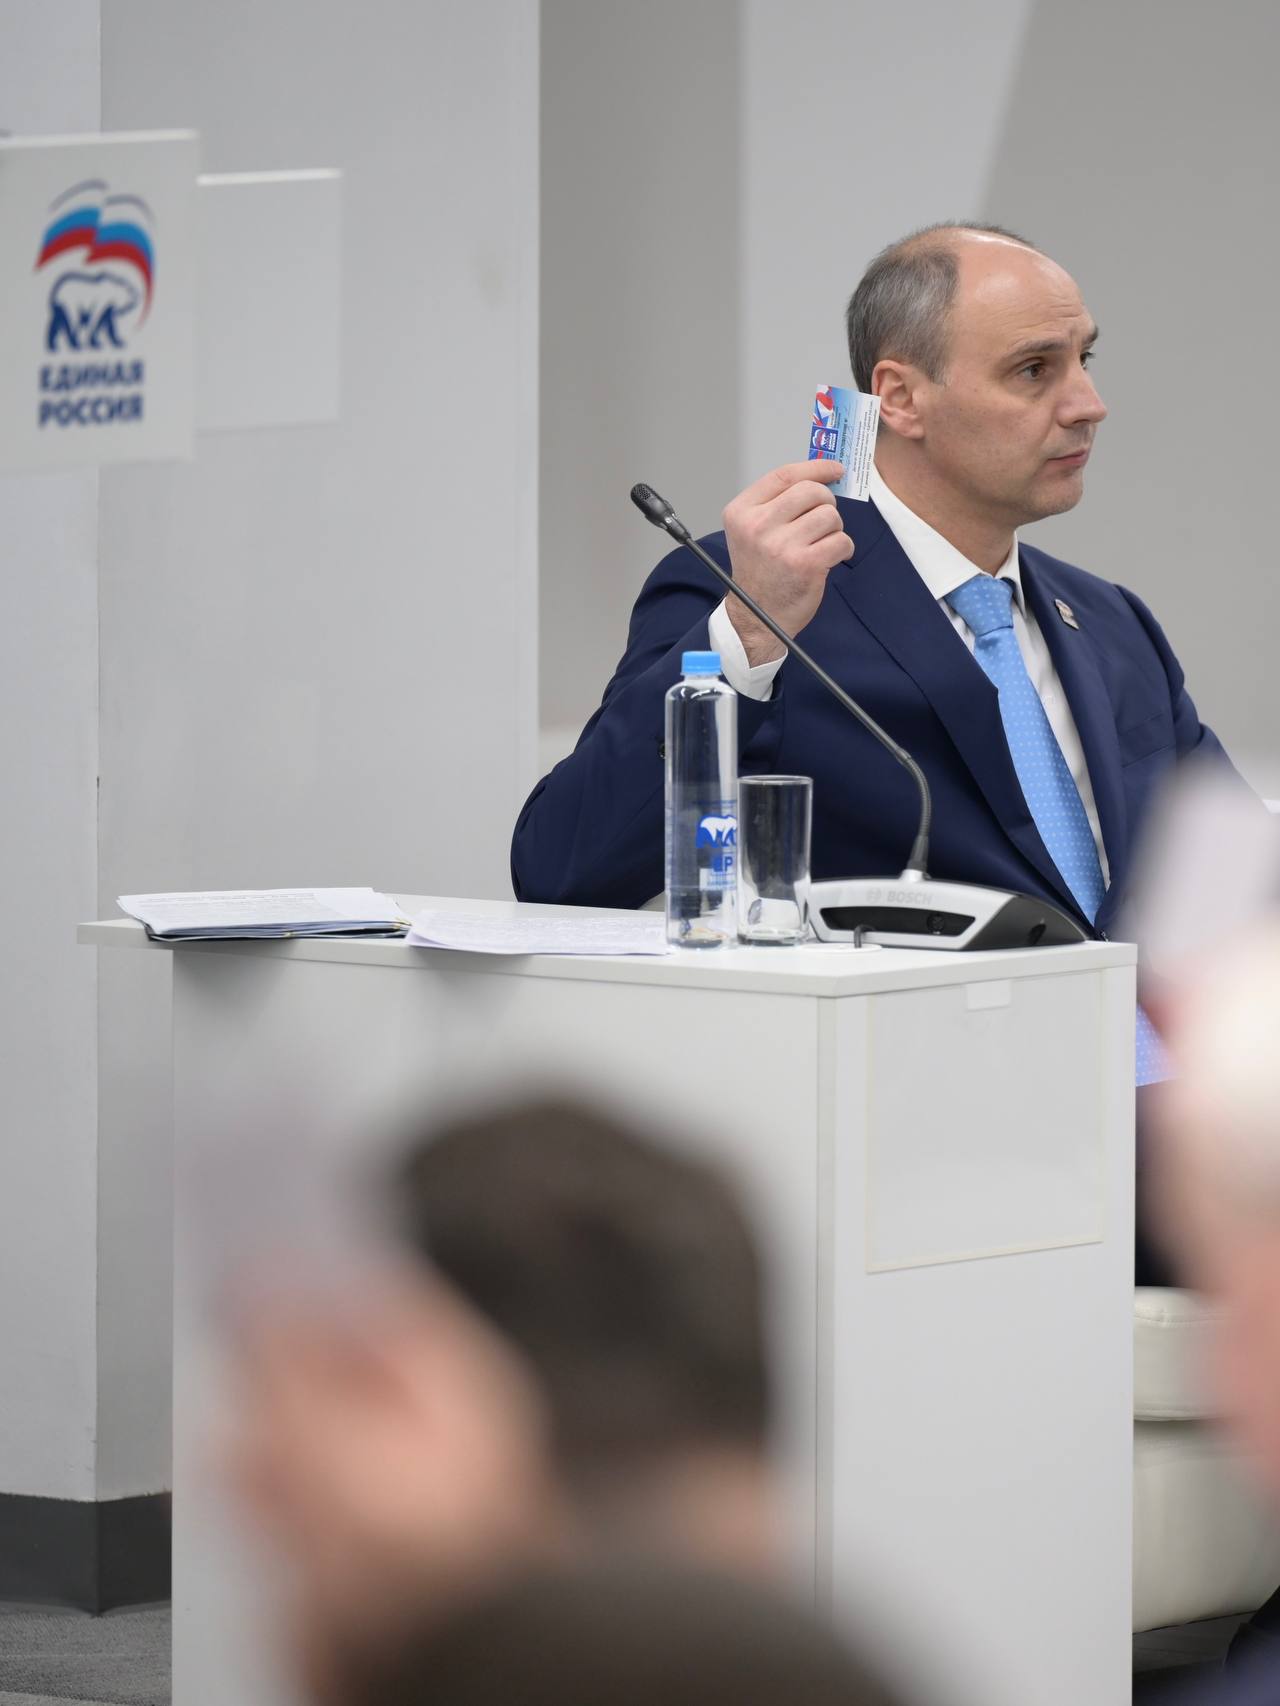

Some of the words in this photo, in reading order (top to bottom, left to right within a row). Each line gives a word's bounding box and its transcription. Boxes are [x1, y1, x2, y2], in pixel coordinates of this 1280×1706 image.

[39, 360, 143, 392] ЕДИНАЯ
[38, 396, 143, 428] РОССИЯ
[887, 890, 933, 904] BOSCH
